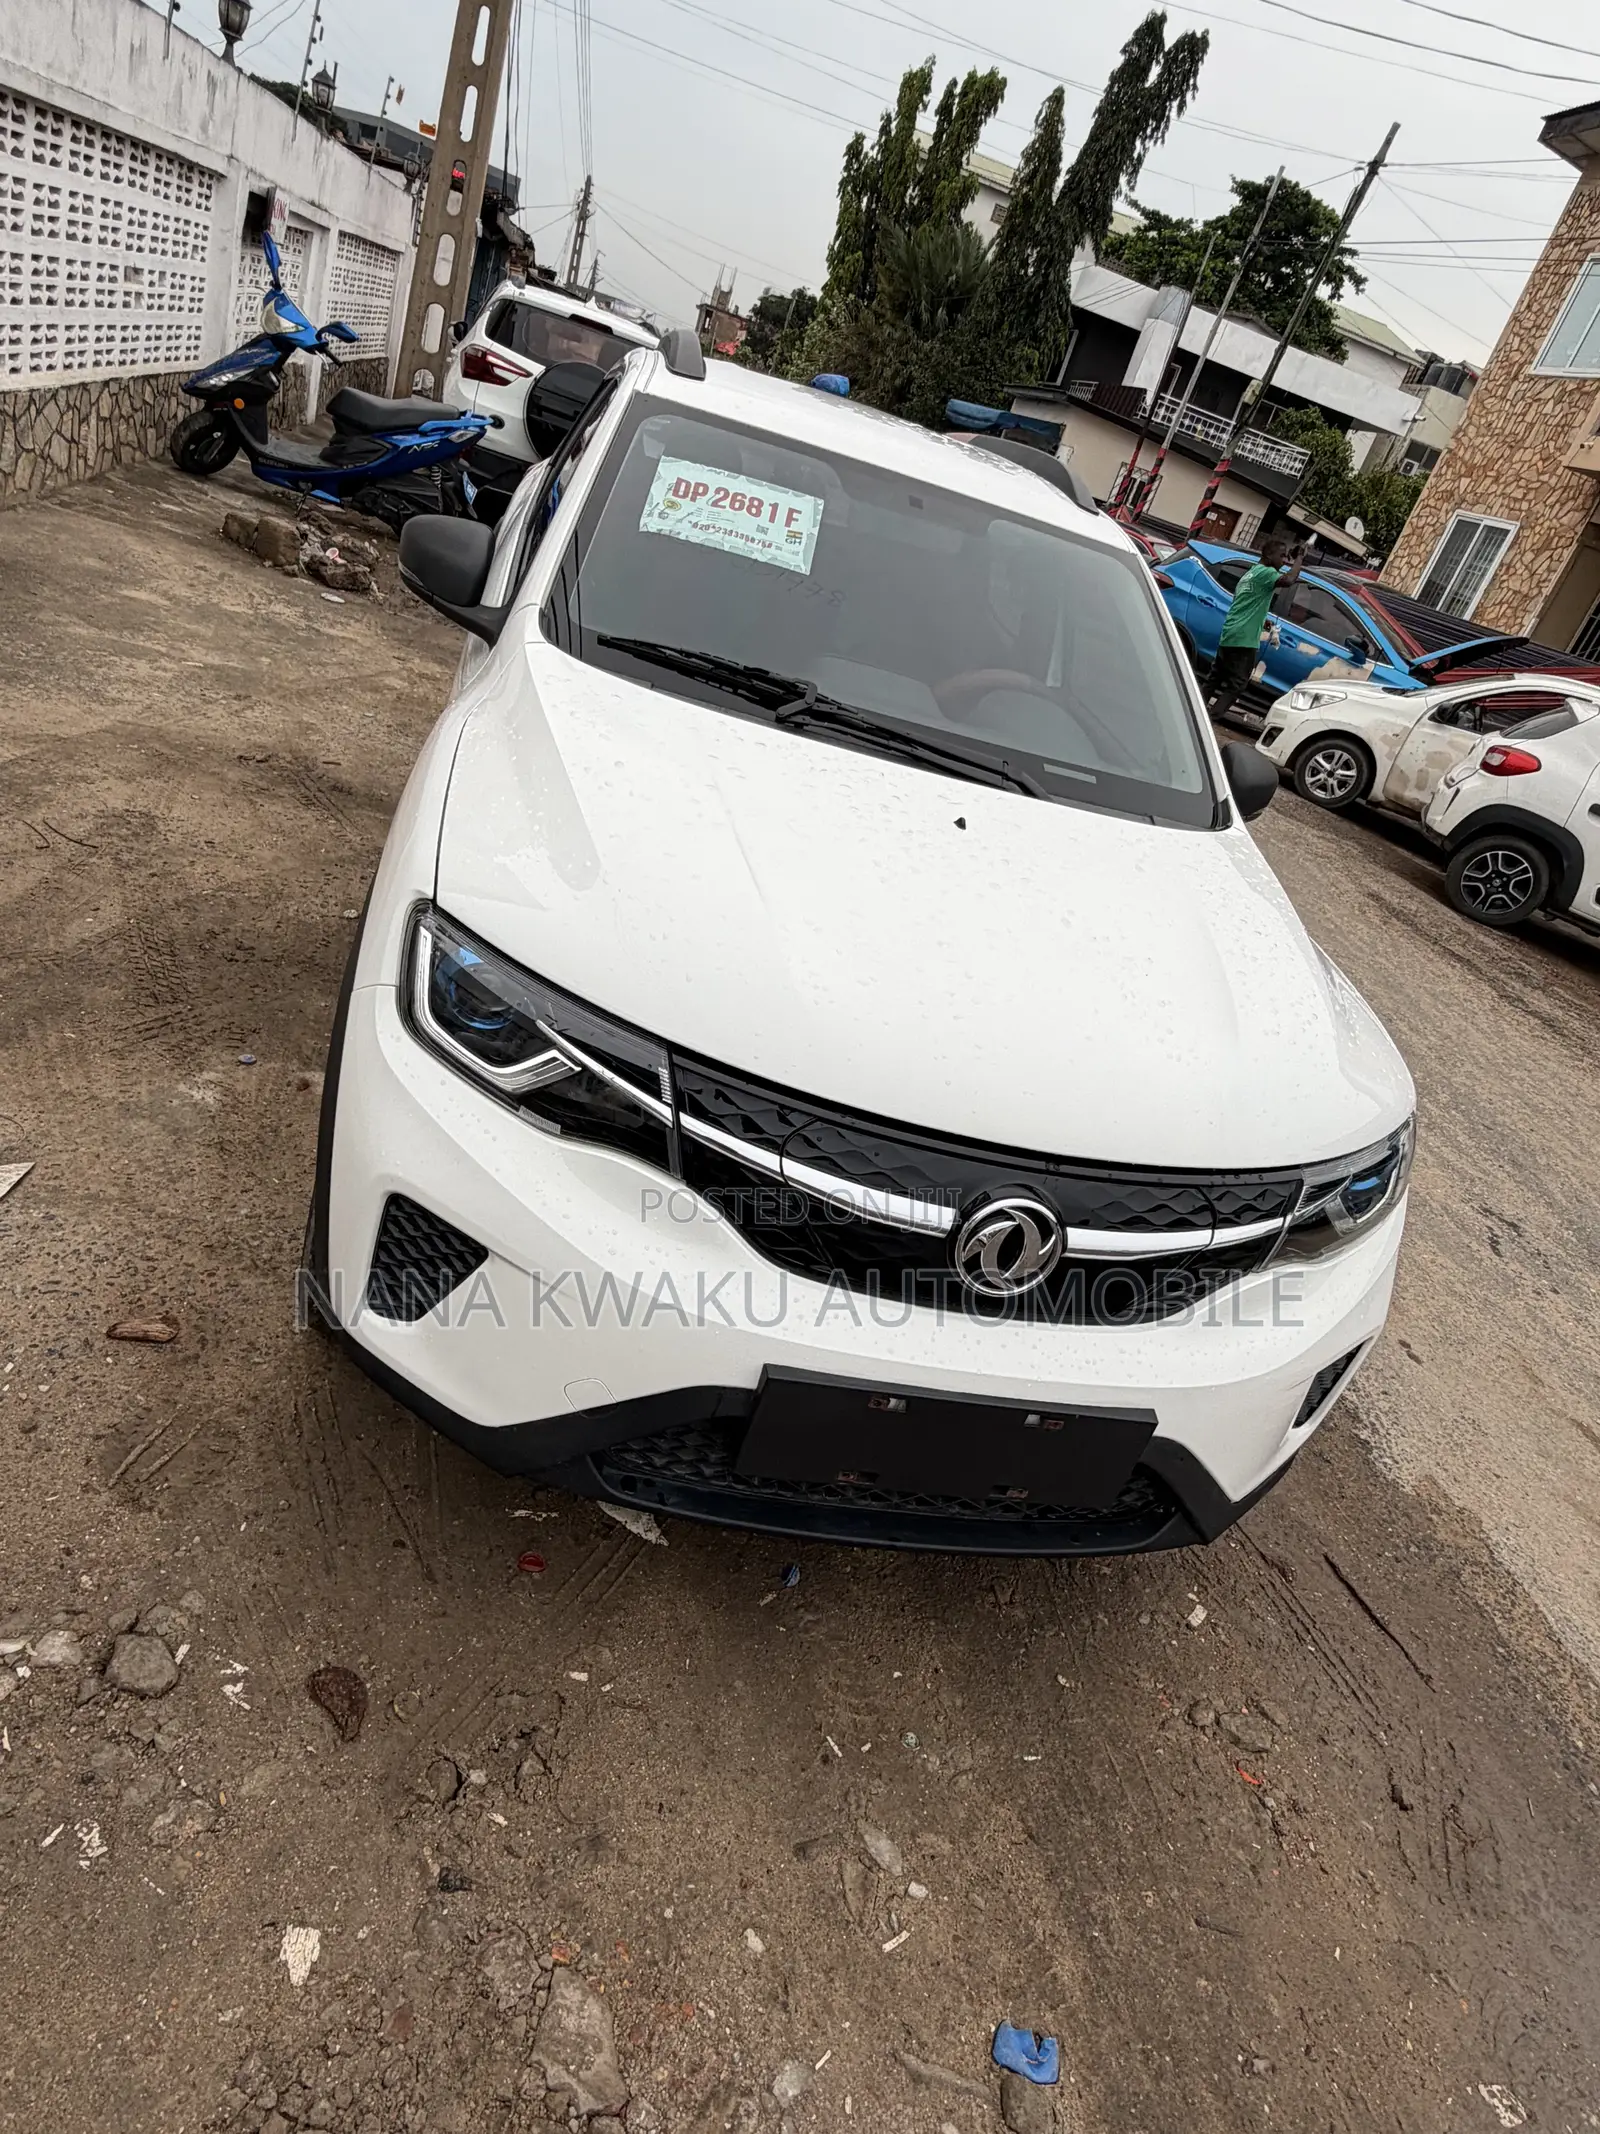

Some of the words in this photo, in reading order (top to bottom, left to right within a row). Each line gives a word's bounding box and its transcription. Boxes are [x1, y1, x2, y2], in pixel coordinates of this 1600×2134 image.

[672, 477, 709, 503] DP
[710, 487, 780, 523] 2681
[784, 507, 802, 528] F
